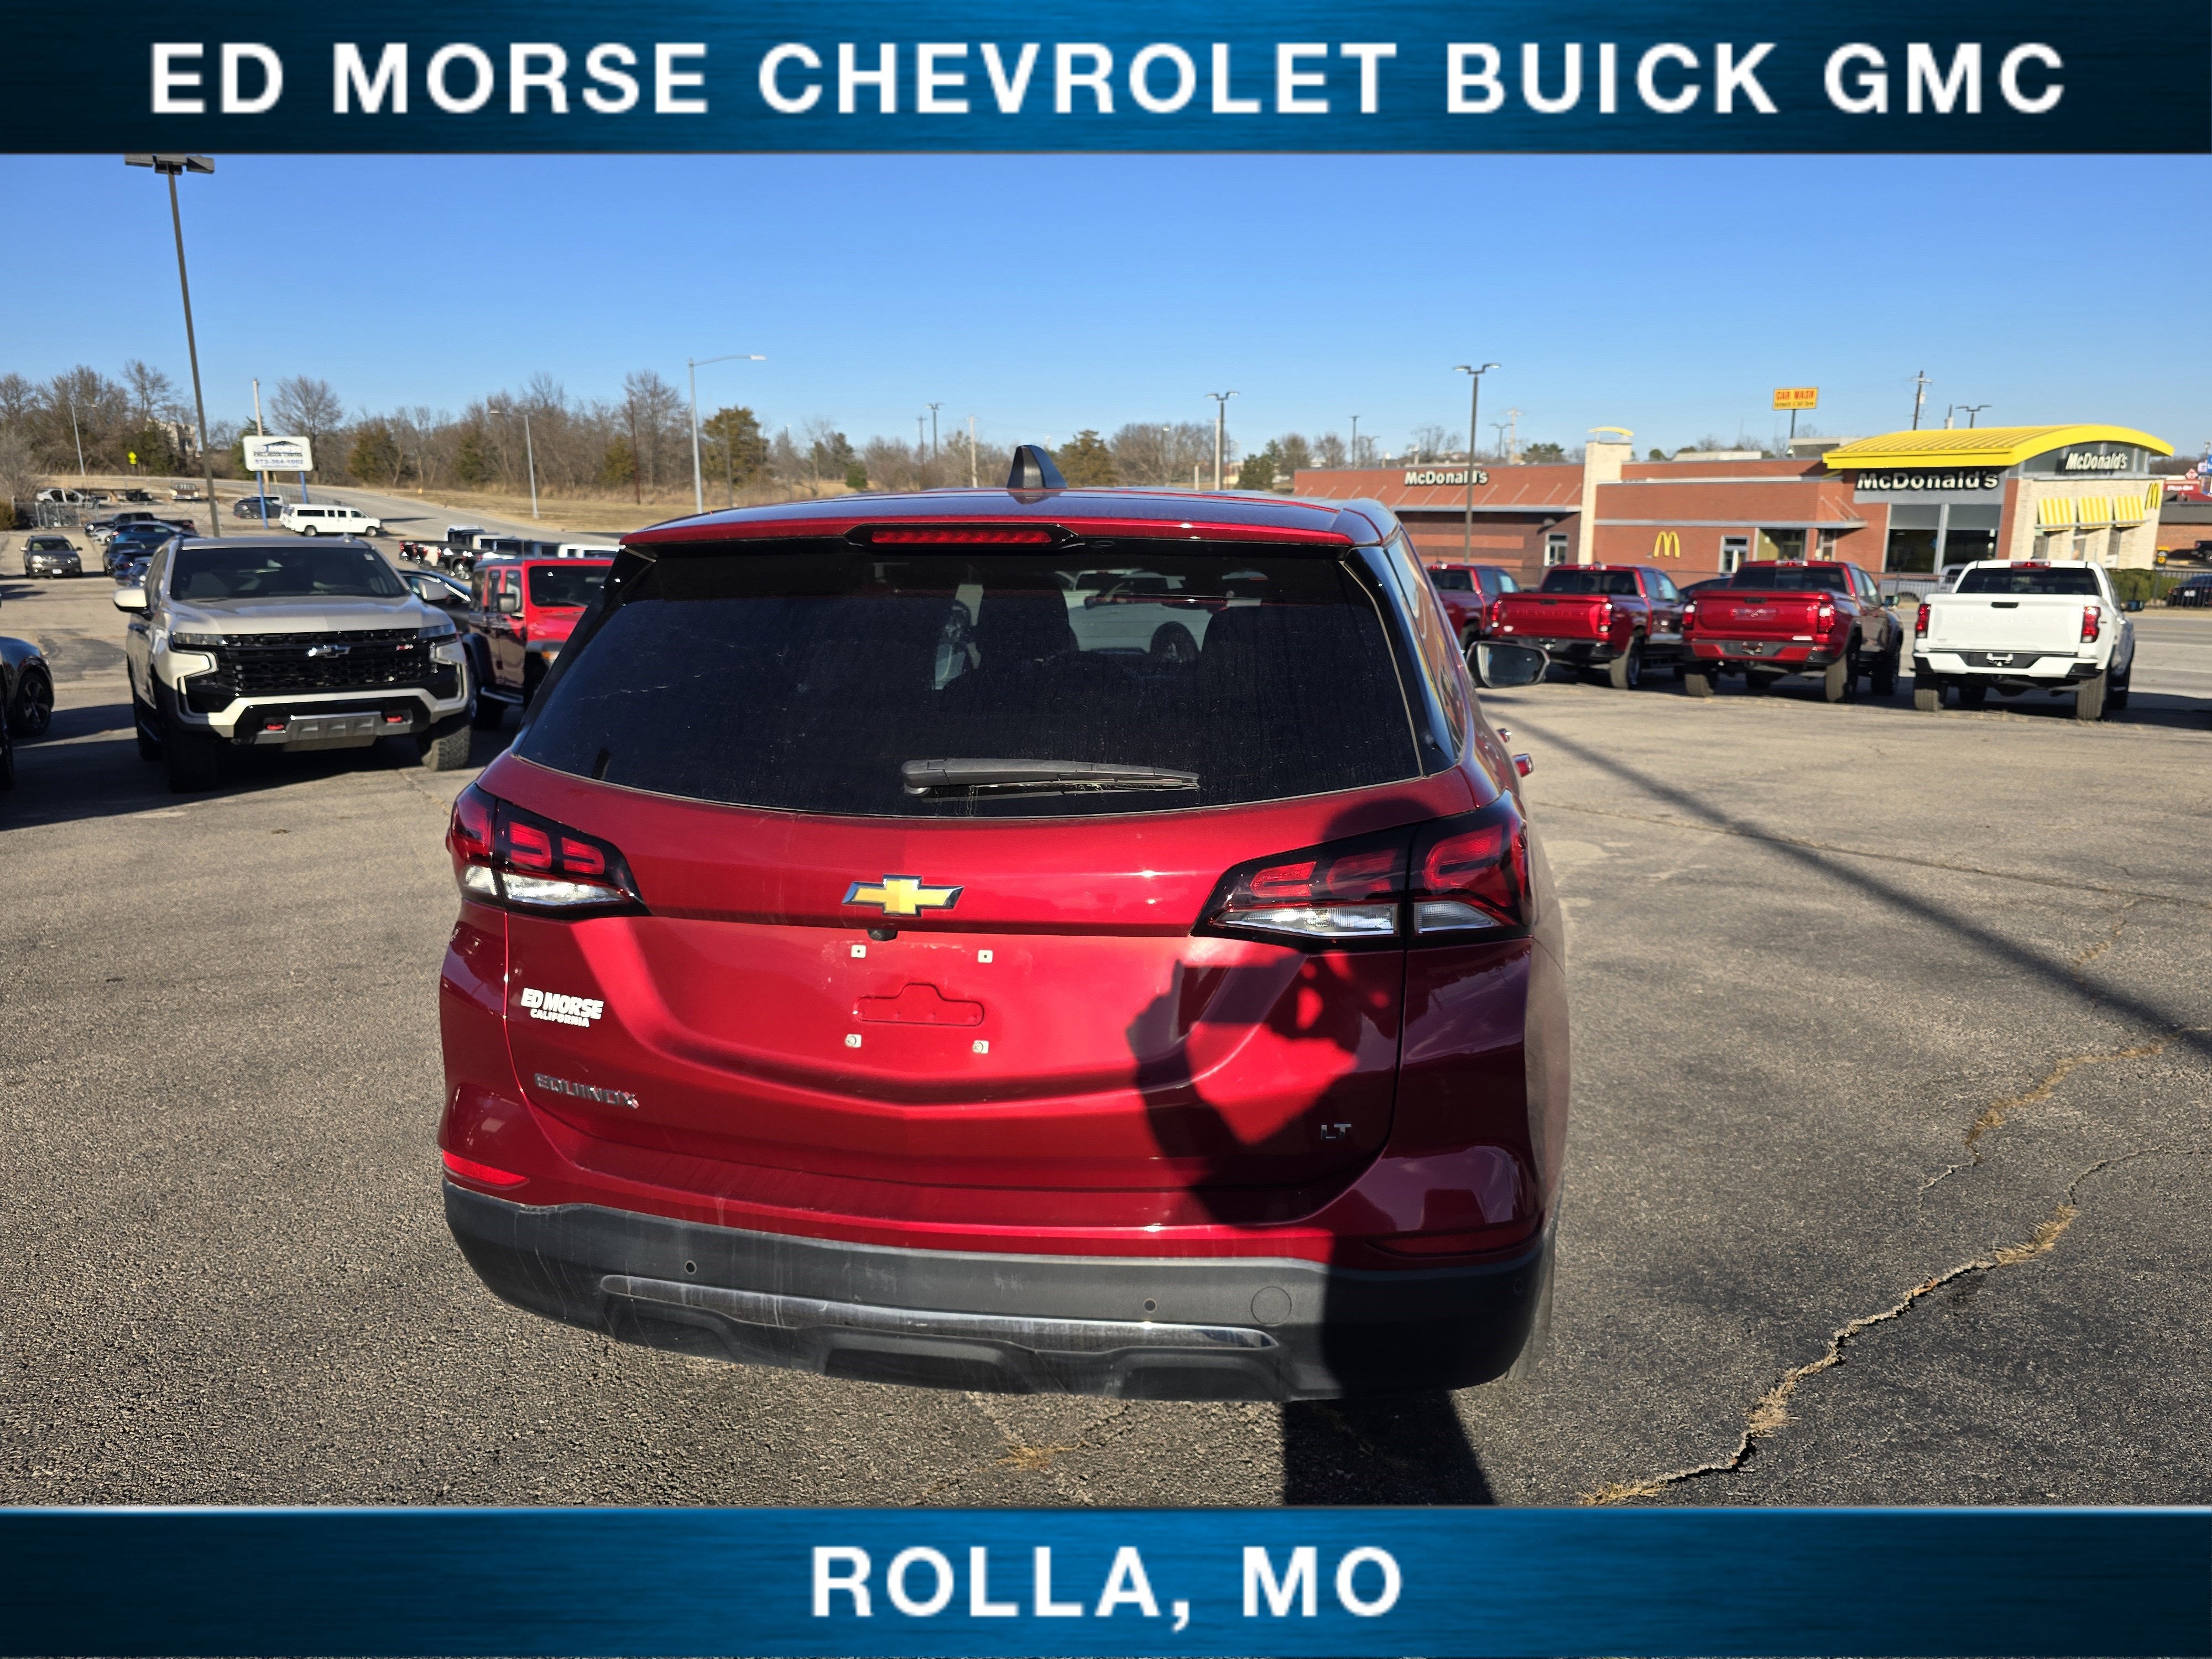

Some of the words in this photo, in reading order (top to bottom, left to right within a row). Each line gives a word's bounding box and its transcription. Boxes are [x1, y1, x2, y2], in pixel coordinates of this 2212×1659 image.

[2065, 452, 2128, 470] McDonald's
[1857, 471, 1998, 489] McDonald's
[521, 988, 544, 1008] ED
[542, 992, 604, 1020] MORSE
[530, 1008, 590, 1027] CALIFORNIA
[534, 1073, 639, 1109] EQUINOX
[1321, 1123, 1352, 1140] LT
